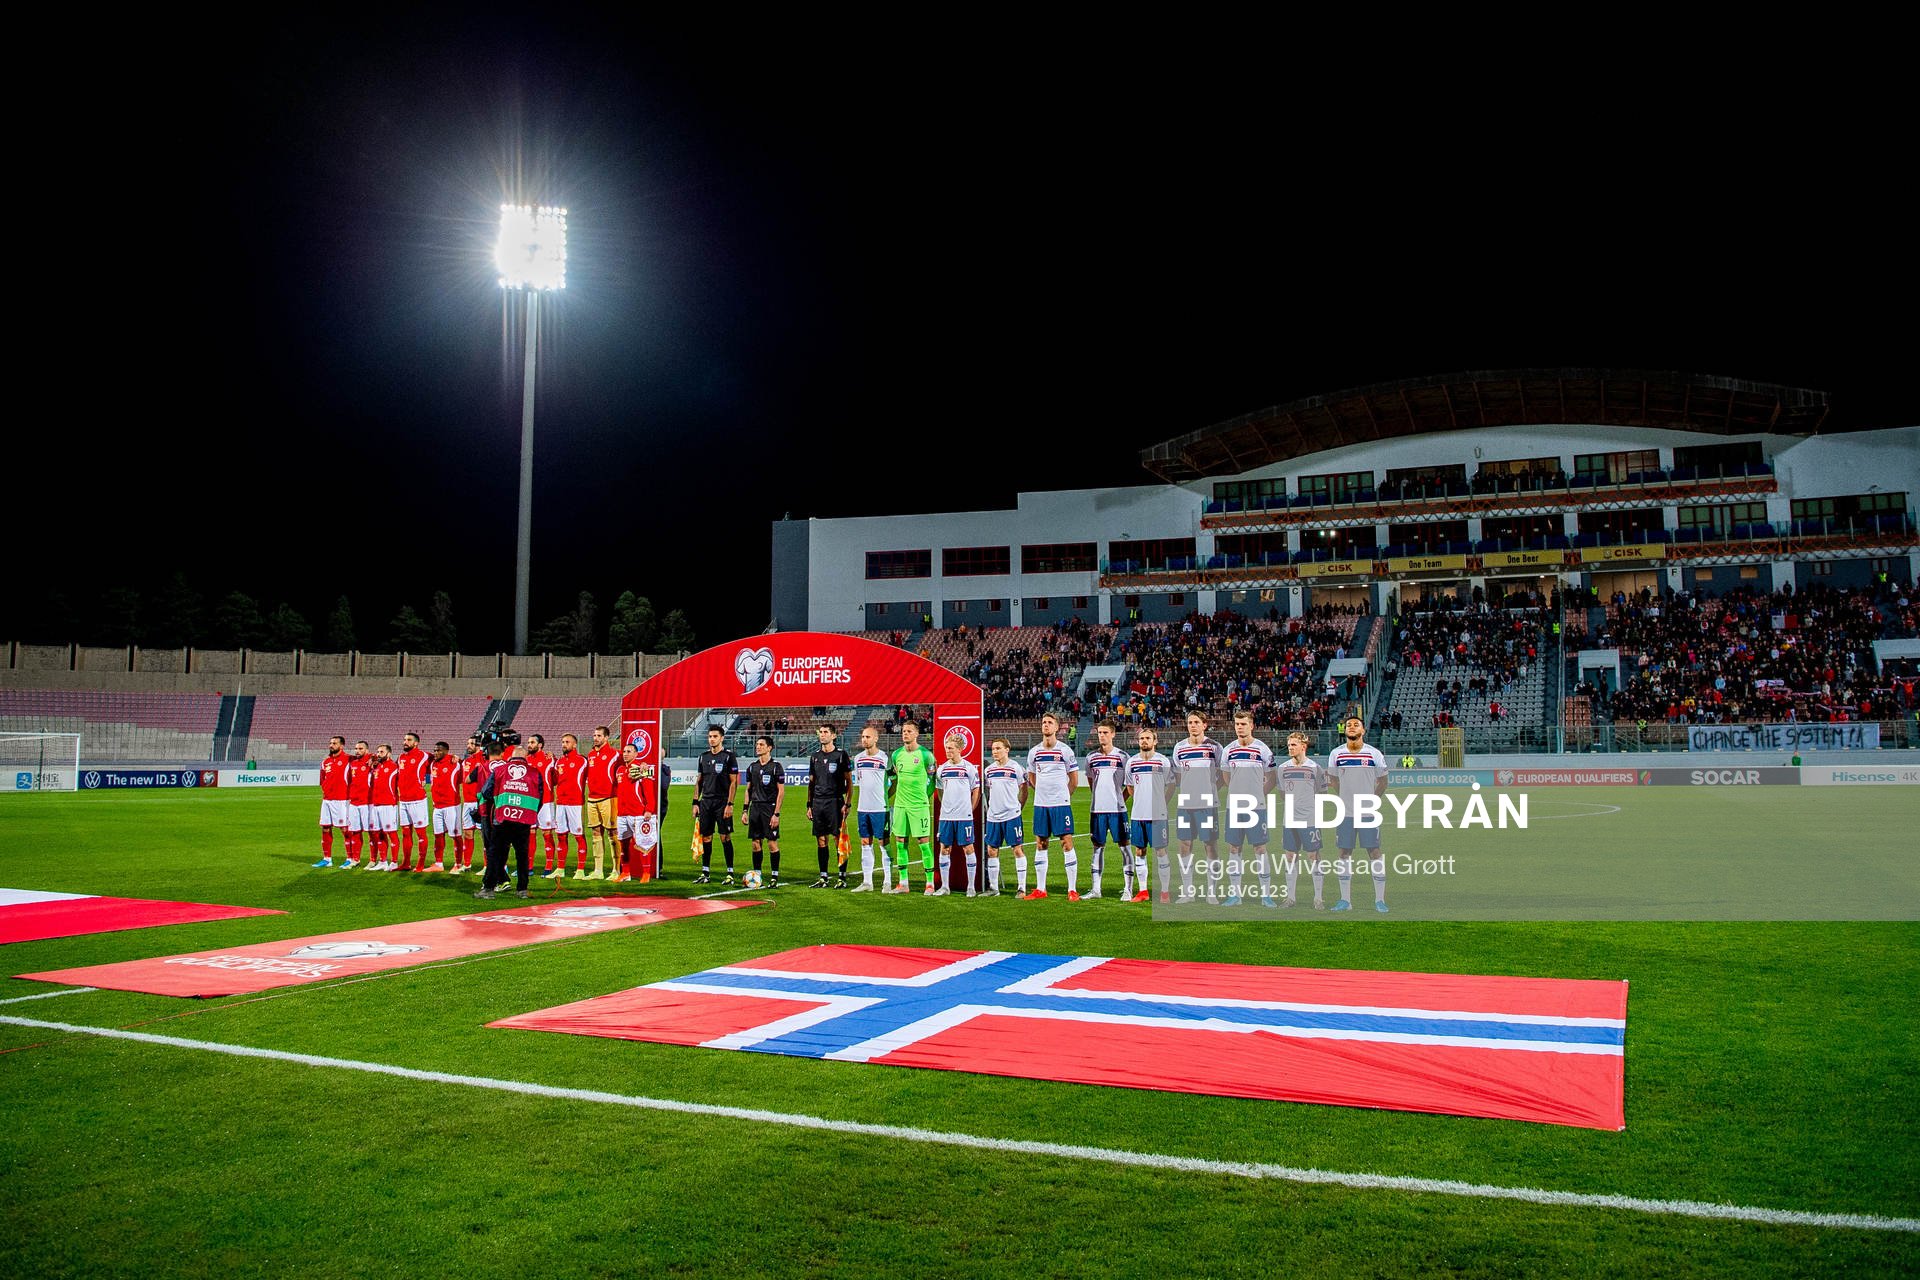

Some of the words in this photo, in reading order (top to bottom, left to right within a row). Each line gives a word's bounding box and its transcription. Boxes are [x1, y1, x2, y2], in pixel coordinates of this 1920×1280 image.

[1614, 548, 1643, 557] CISK
[1408, 560, 1422, 569] One
[1424, 559, 1442, 568] Team
[1507, 555, 1520, 564] One
[1522, 554, 1539, 563] Beer
[1328, 564, 1353, 572] CISK
[1291, 587, 1299, 595] C
[782, 656, 844, 669] EUROPEAN
[774, 669, 851, 687] QUALIFIERS
[1692, 731, 1750, 750] CHANGE
[1753, 727, 1781, 748] THE
[1786, 727, 1845, 747] SYSTEM
[106, 774, 129, 785] The
[131, 775, 153, 785] new
[155, 774, 177, 785] ID.3
[237, 774, 277, 783] Hisense
[280, 774, 289, 782] 4K
[291, 774, 301, 782] TV
[1387, 775, 1415, 784] UEFA
[1417, 775, 1446, 784] EURO
[1448, 775, 1477, 784] 2020
[1517, 774, 1572, 784] EUROPEAN
[1574, 774, 1634, 784] QUALIFIERS
[1690, 770, 1761, 785] SOCAR
[1831, 771, 1896, 782] Hisense
[1903, 772, 1918, 782] 4K
[508, 794, 522, 805] HB
[503, 807, 524, 819] 027
[920, 817, 929, 828] 12
[1064, 815, 1071, 826] 3
[1014, 826, 1023, 838] 16
[1162, 828, 1167, 839] 8
